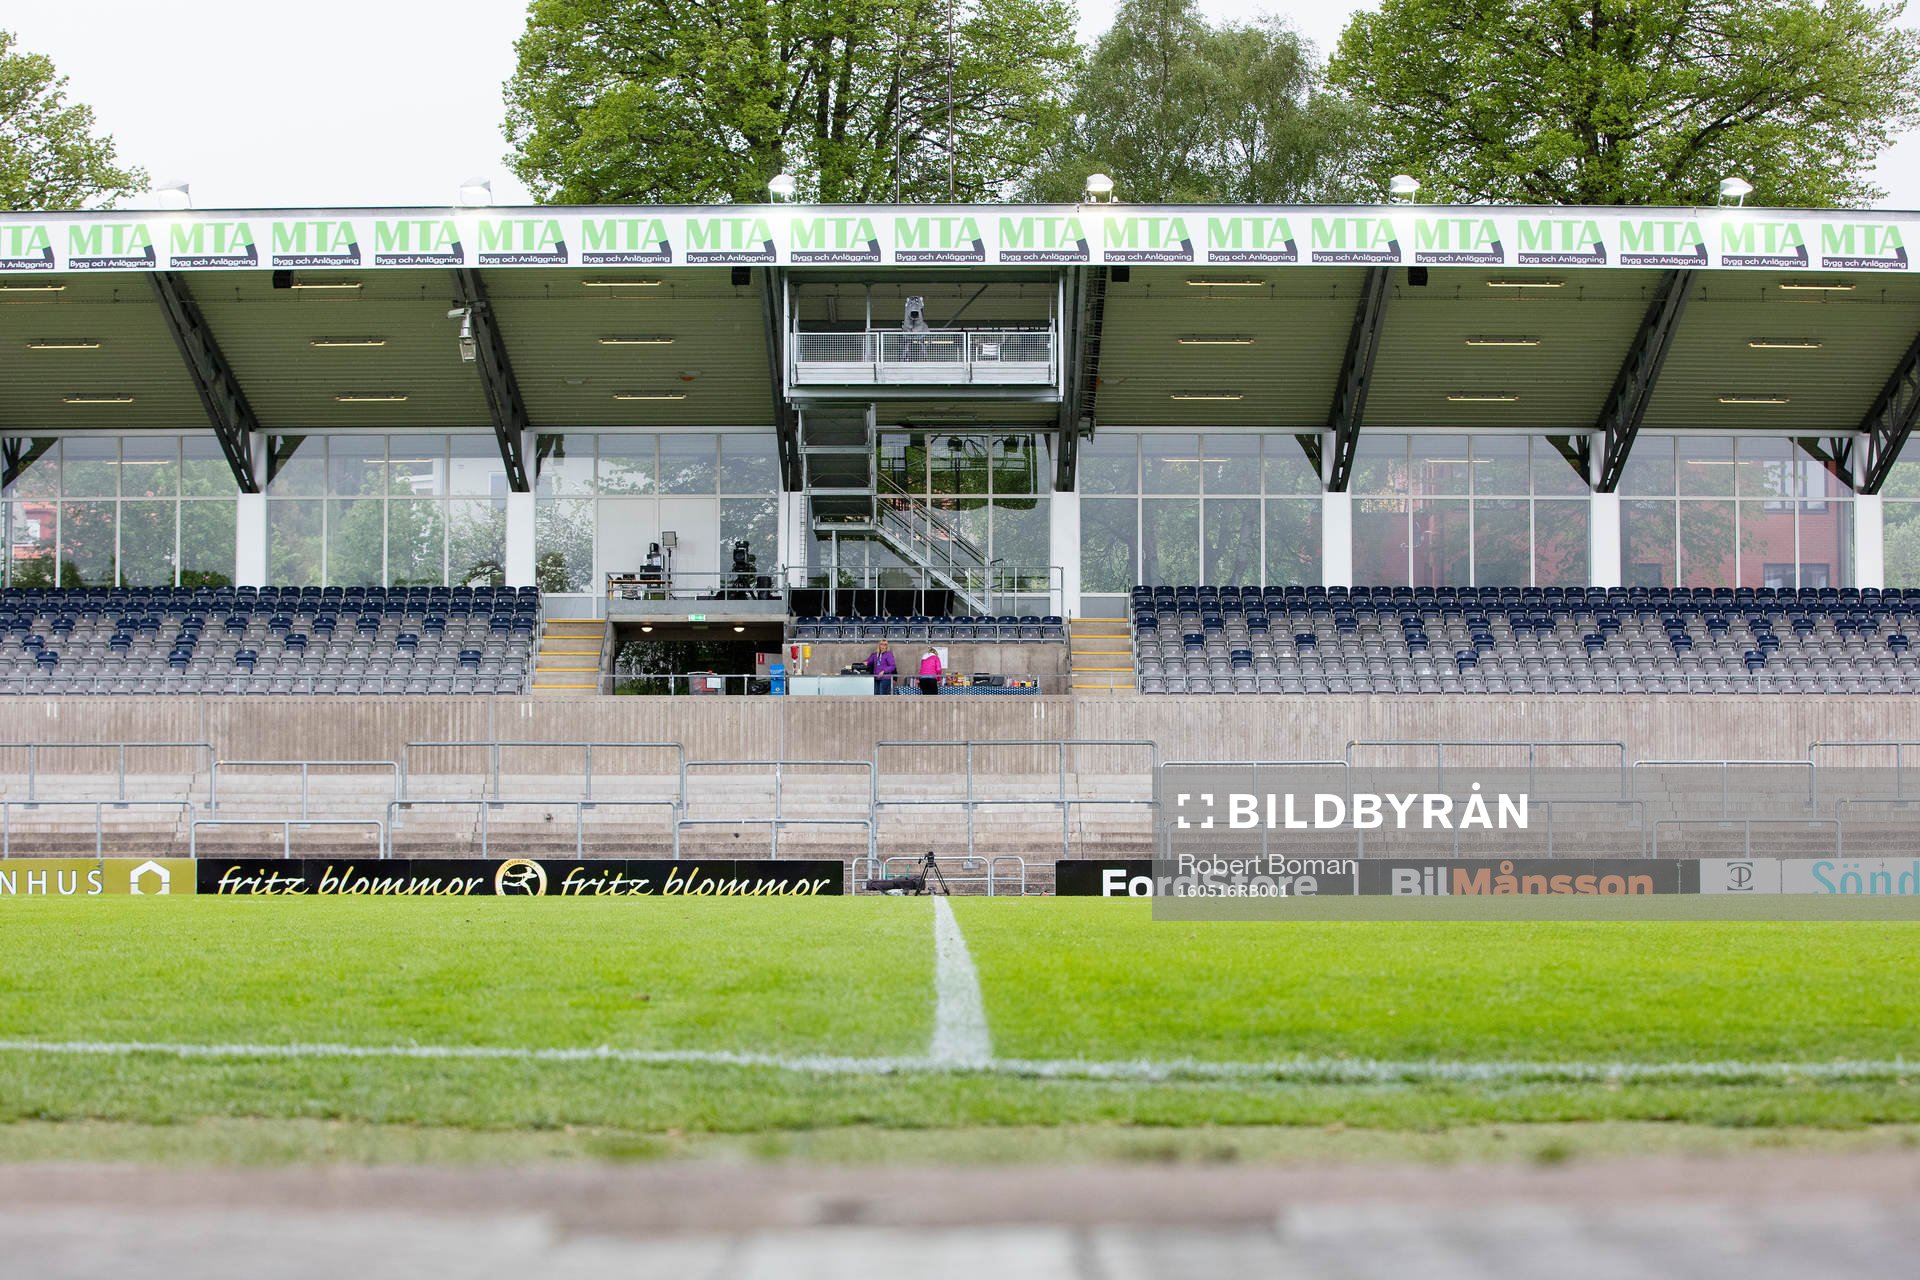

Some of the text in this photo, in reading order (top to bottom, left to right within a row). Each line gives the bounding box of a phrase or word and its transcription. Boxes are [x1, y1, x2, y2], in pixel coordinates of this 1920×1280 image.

[0, 225, 54, 257] TA
[69, 224, 155, 255] MTA
[170, 223, 257, 253] MTA
[272, 222, 360, 252] MTA
[376, 221, 463, 251] MTA
[479, 219, 567, 250] MTA
[582, 219, 671, 250] MTA
[686, 218, 775, 249] MTA
[791, 218, 880, 249] MTA
[896, 217, 984, 248] MTA
[1000, 217, 1088, 248] MTA
[1104, 217, 1193, 248] MTA
[1208, 217, 1297, 248] MTA
[1312, 218, 1400, 248] MTA
[1415, 219, 1503, 249] MTA
[1519, 220, 1605, 250] MTA
[1620, 221, 1707, 251] MTA
[1722, 223, 1807, 252] MTA
[1822, 224, 1907, 255] MTA
[218, 865, 309, 895] fritz
[318, 865, 484, 895] blommor
[561, 867, 654, 896] fritz
[662, 866, 830, 896] blommor
